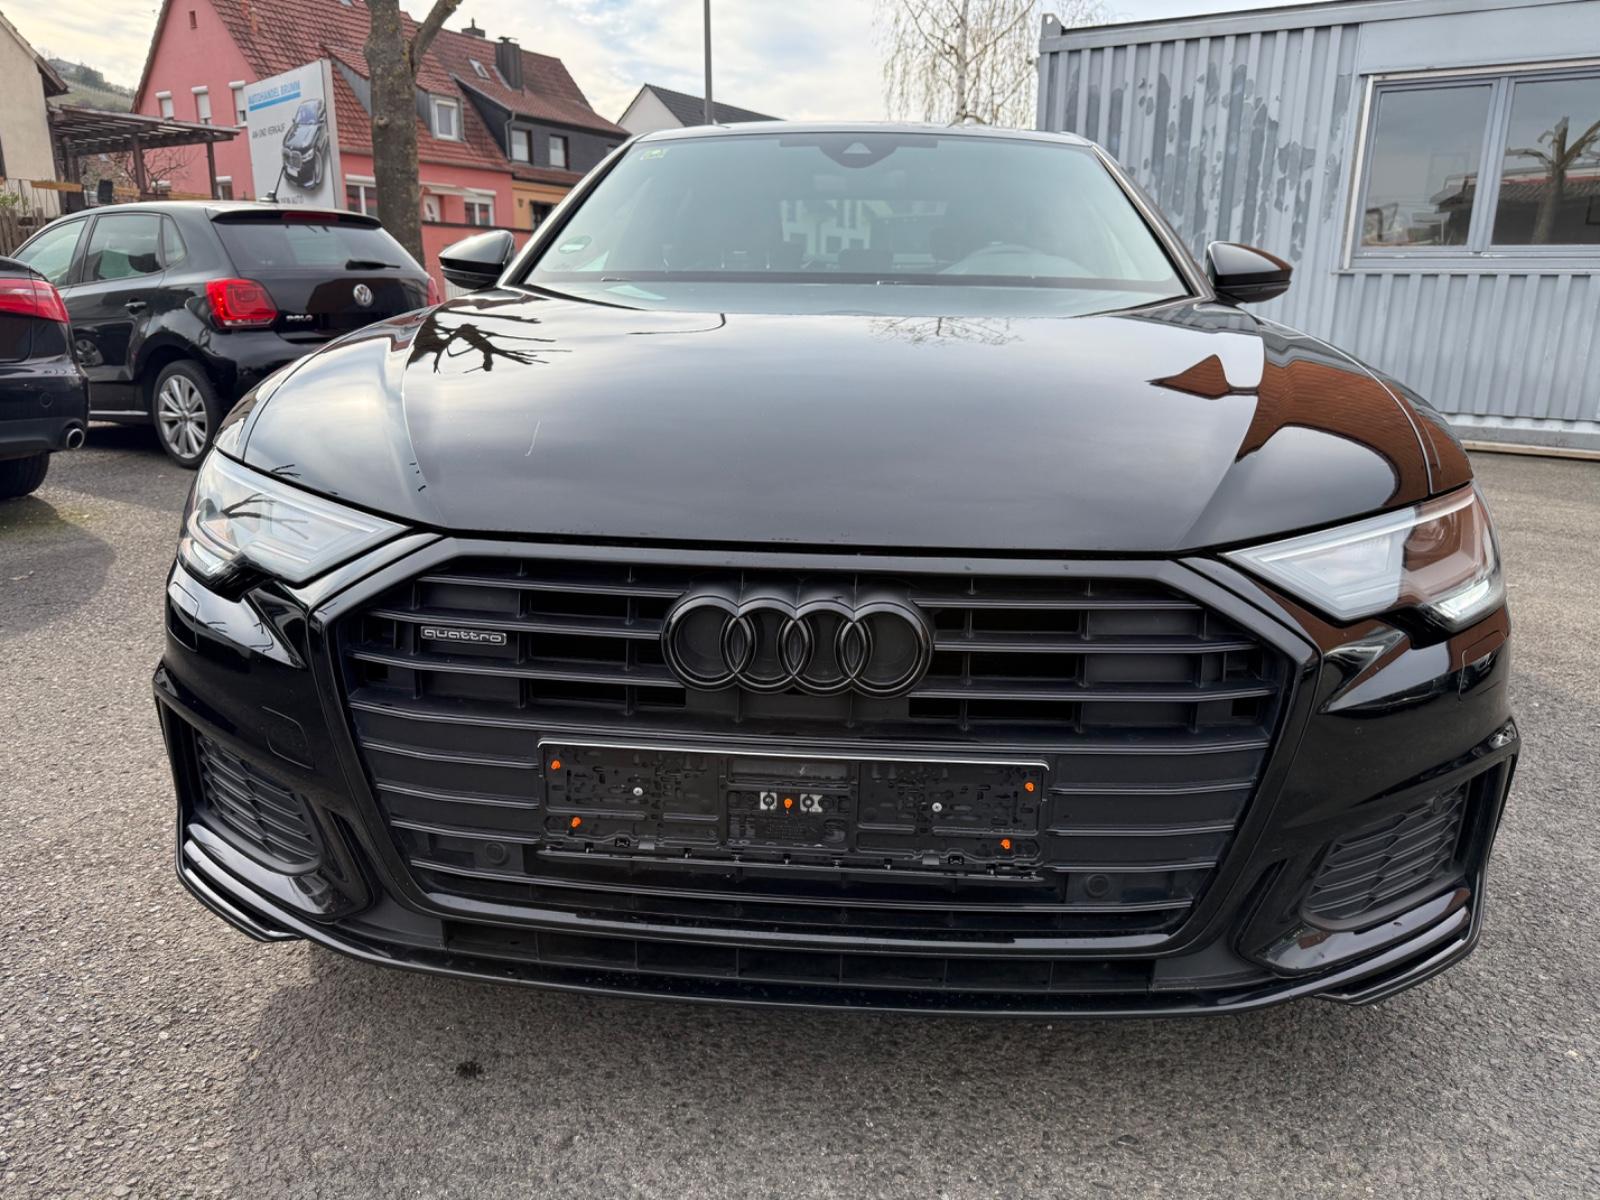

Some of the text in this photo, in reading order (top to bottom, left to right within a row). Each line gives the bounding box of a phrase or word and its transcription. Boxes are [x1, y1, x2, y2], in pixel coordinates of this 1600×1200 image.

[248, 87, 280, 104] AUTOHANDEL
[286, 314, 313, 322] POLO
[424, 628, 502, 643] quattro
